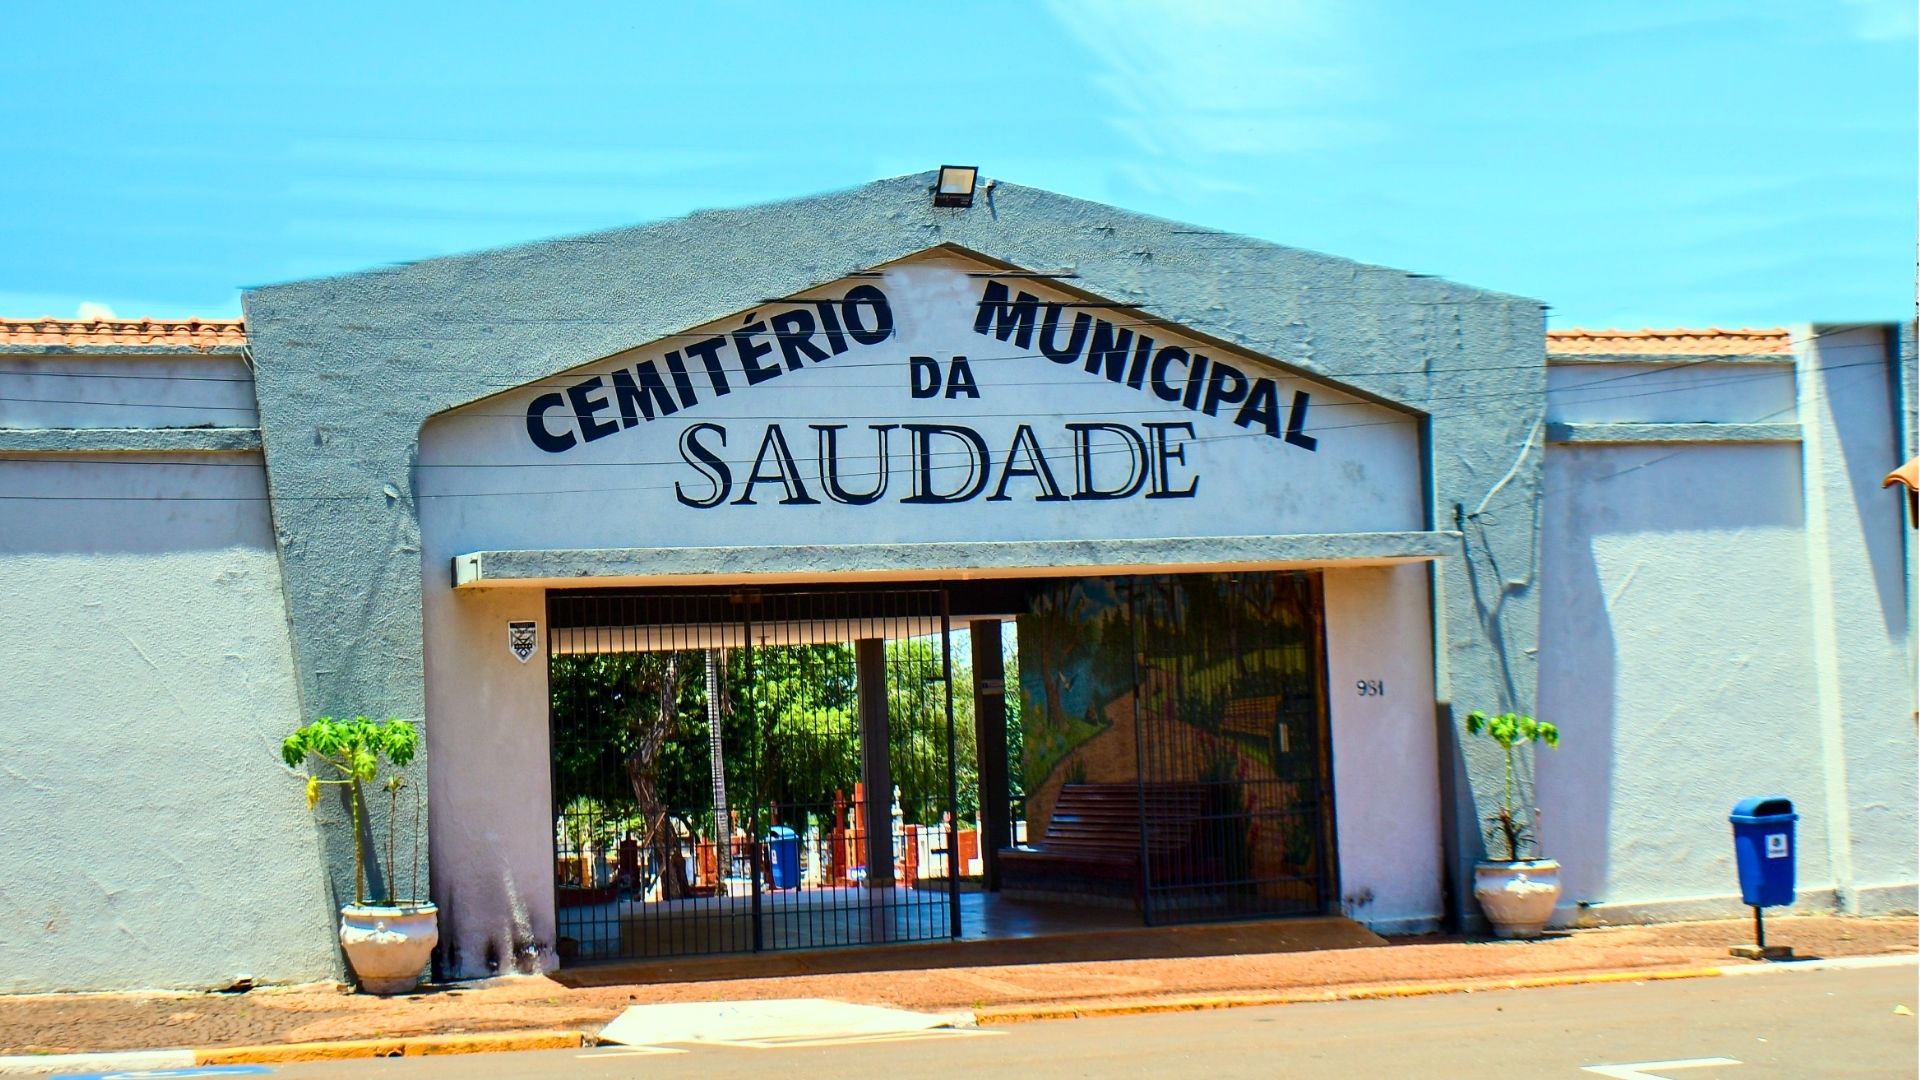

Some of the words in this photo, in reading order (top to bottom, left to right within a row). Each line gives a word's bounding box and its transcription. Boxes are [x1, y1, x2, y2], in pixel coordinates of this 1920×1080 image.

[526, 284, 894, 453] CEMITÉRIO
[973, 280, 1318, 452] MUNICIPAL
[910, 356, 981, 400] DA
[674, 421, 1201, 509] SAUDADE
